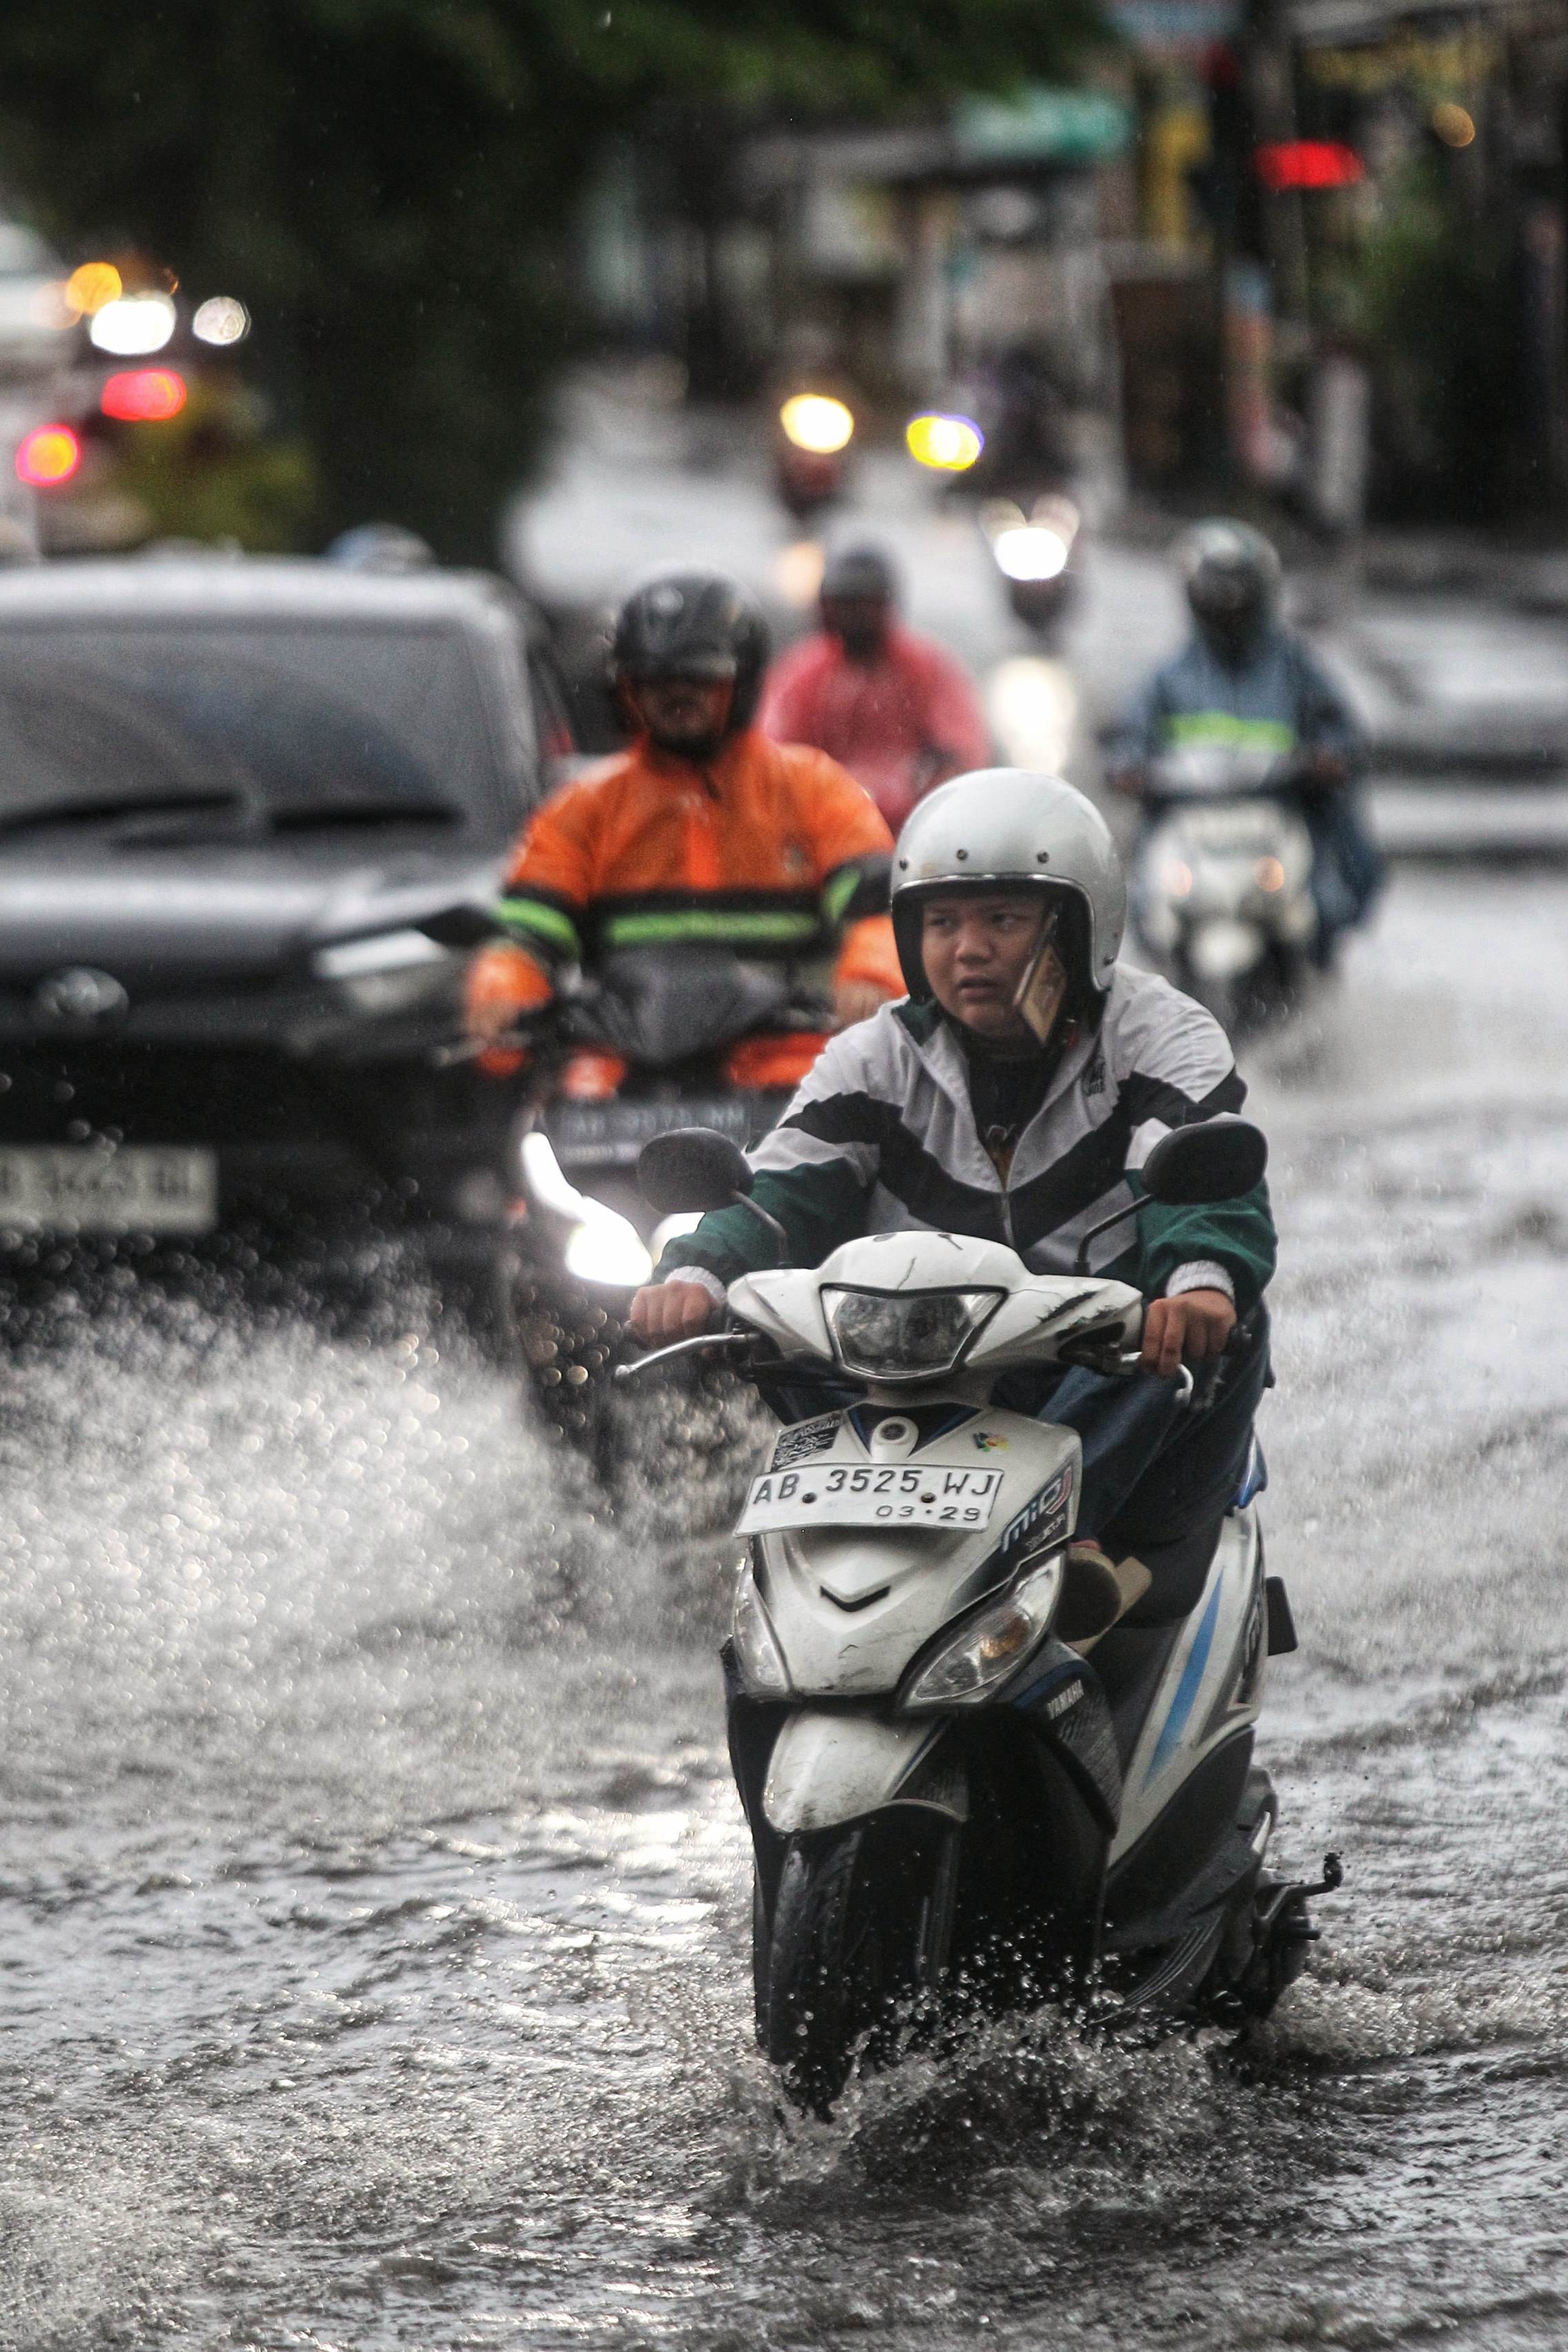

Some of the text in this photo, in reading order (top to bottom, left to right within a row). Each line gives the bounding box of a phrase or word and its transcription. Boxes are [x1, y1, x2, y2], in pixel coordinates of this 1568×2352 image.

[753, 1468, 996, 1504] AB 3525 WJ
[1046, 1679, 1085, 1720] YAMAHA
